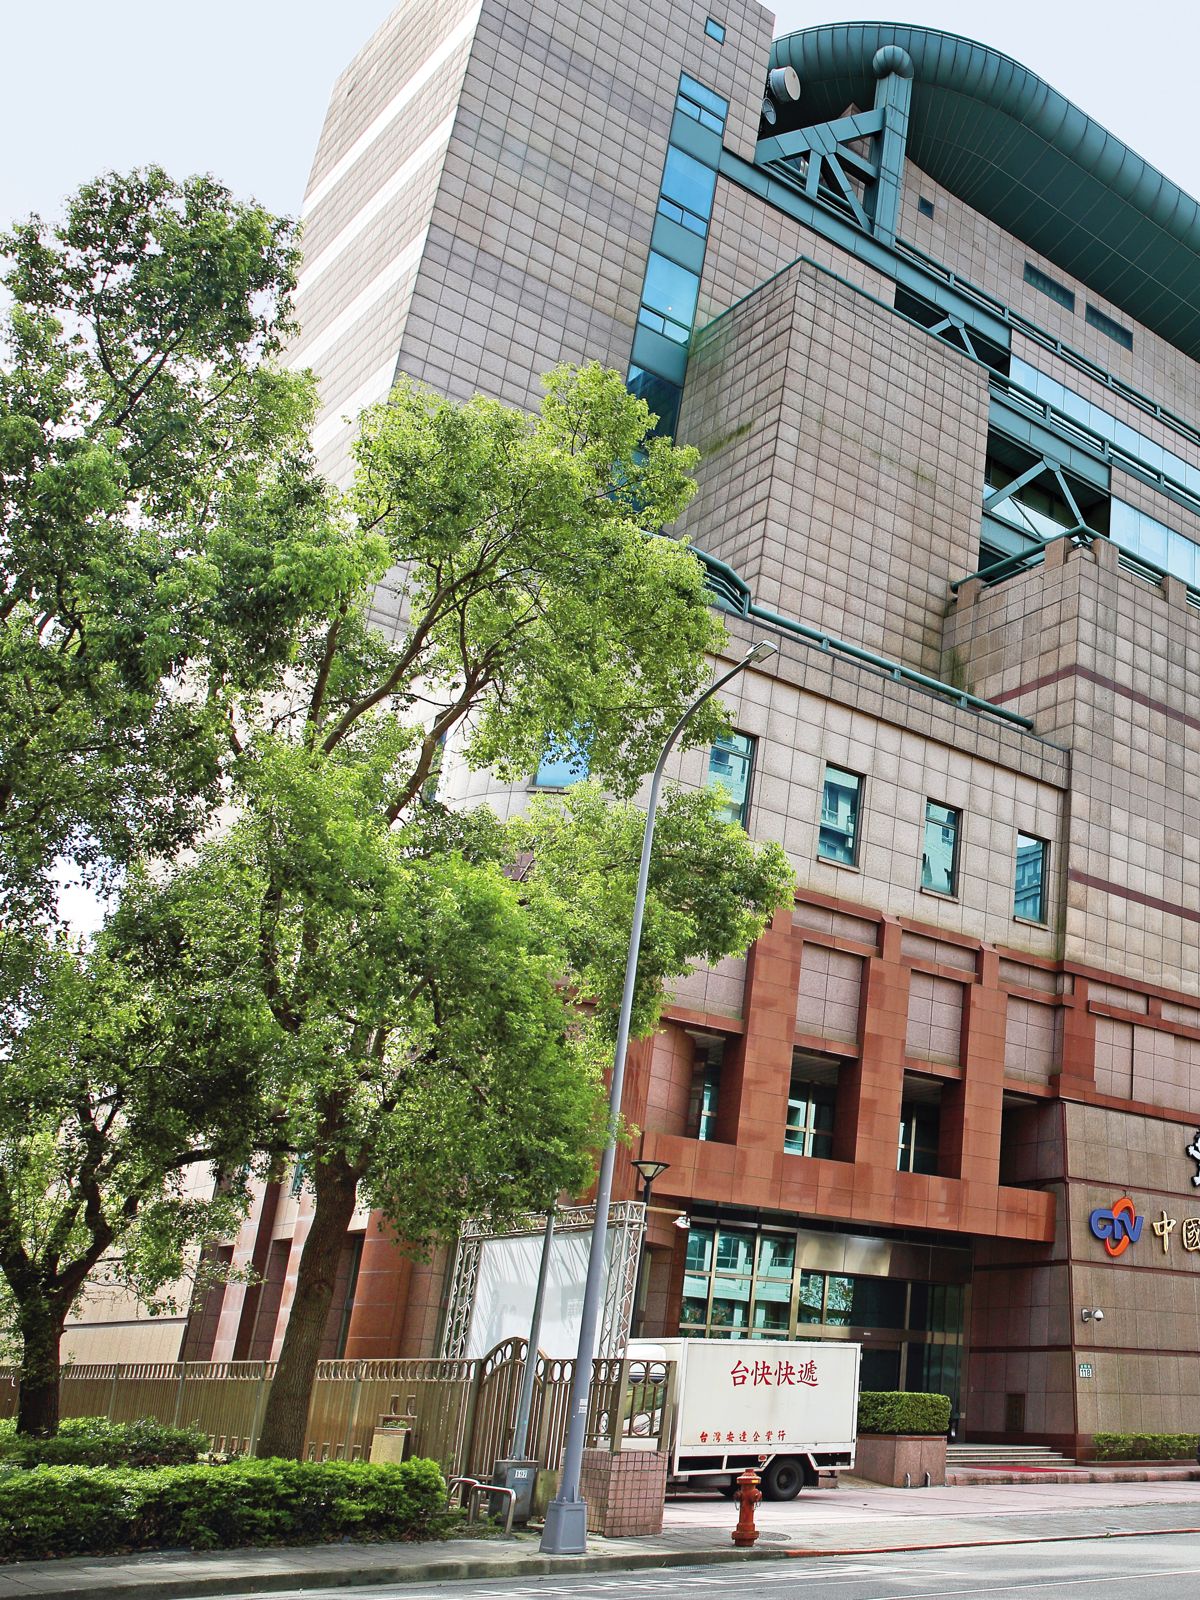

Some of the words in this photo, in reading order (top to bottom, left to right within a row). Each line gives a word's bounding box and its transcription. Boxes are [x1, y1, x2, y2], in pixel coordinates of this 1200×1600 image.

[730, 1360, 819, 1387] 台快快遞
[699, 1430, 787, 1443] 台灣安達企業行
